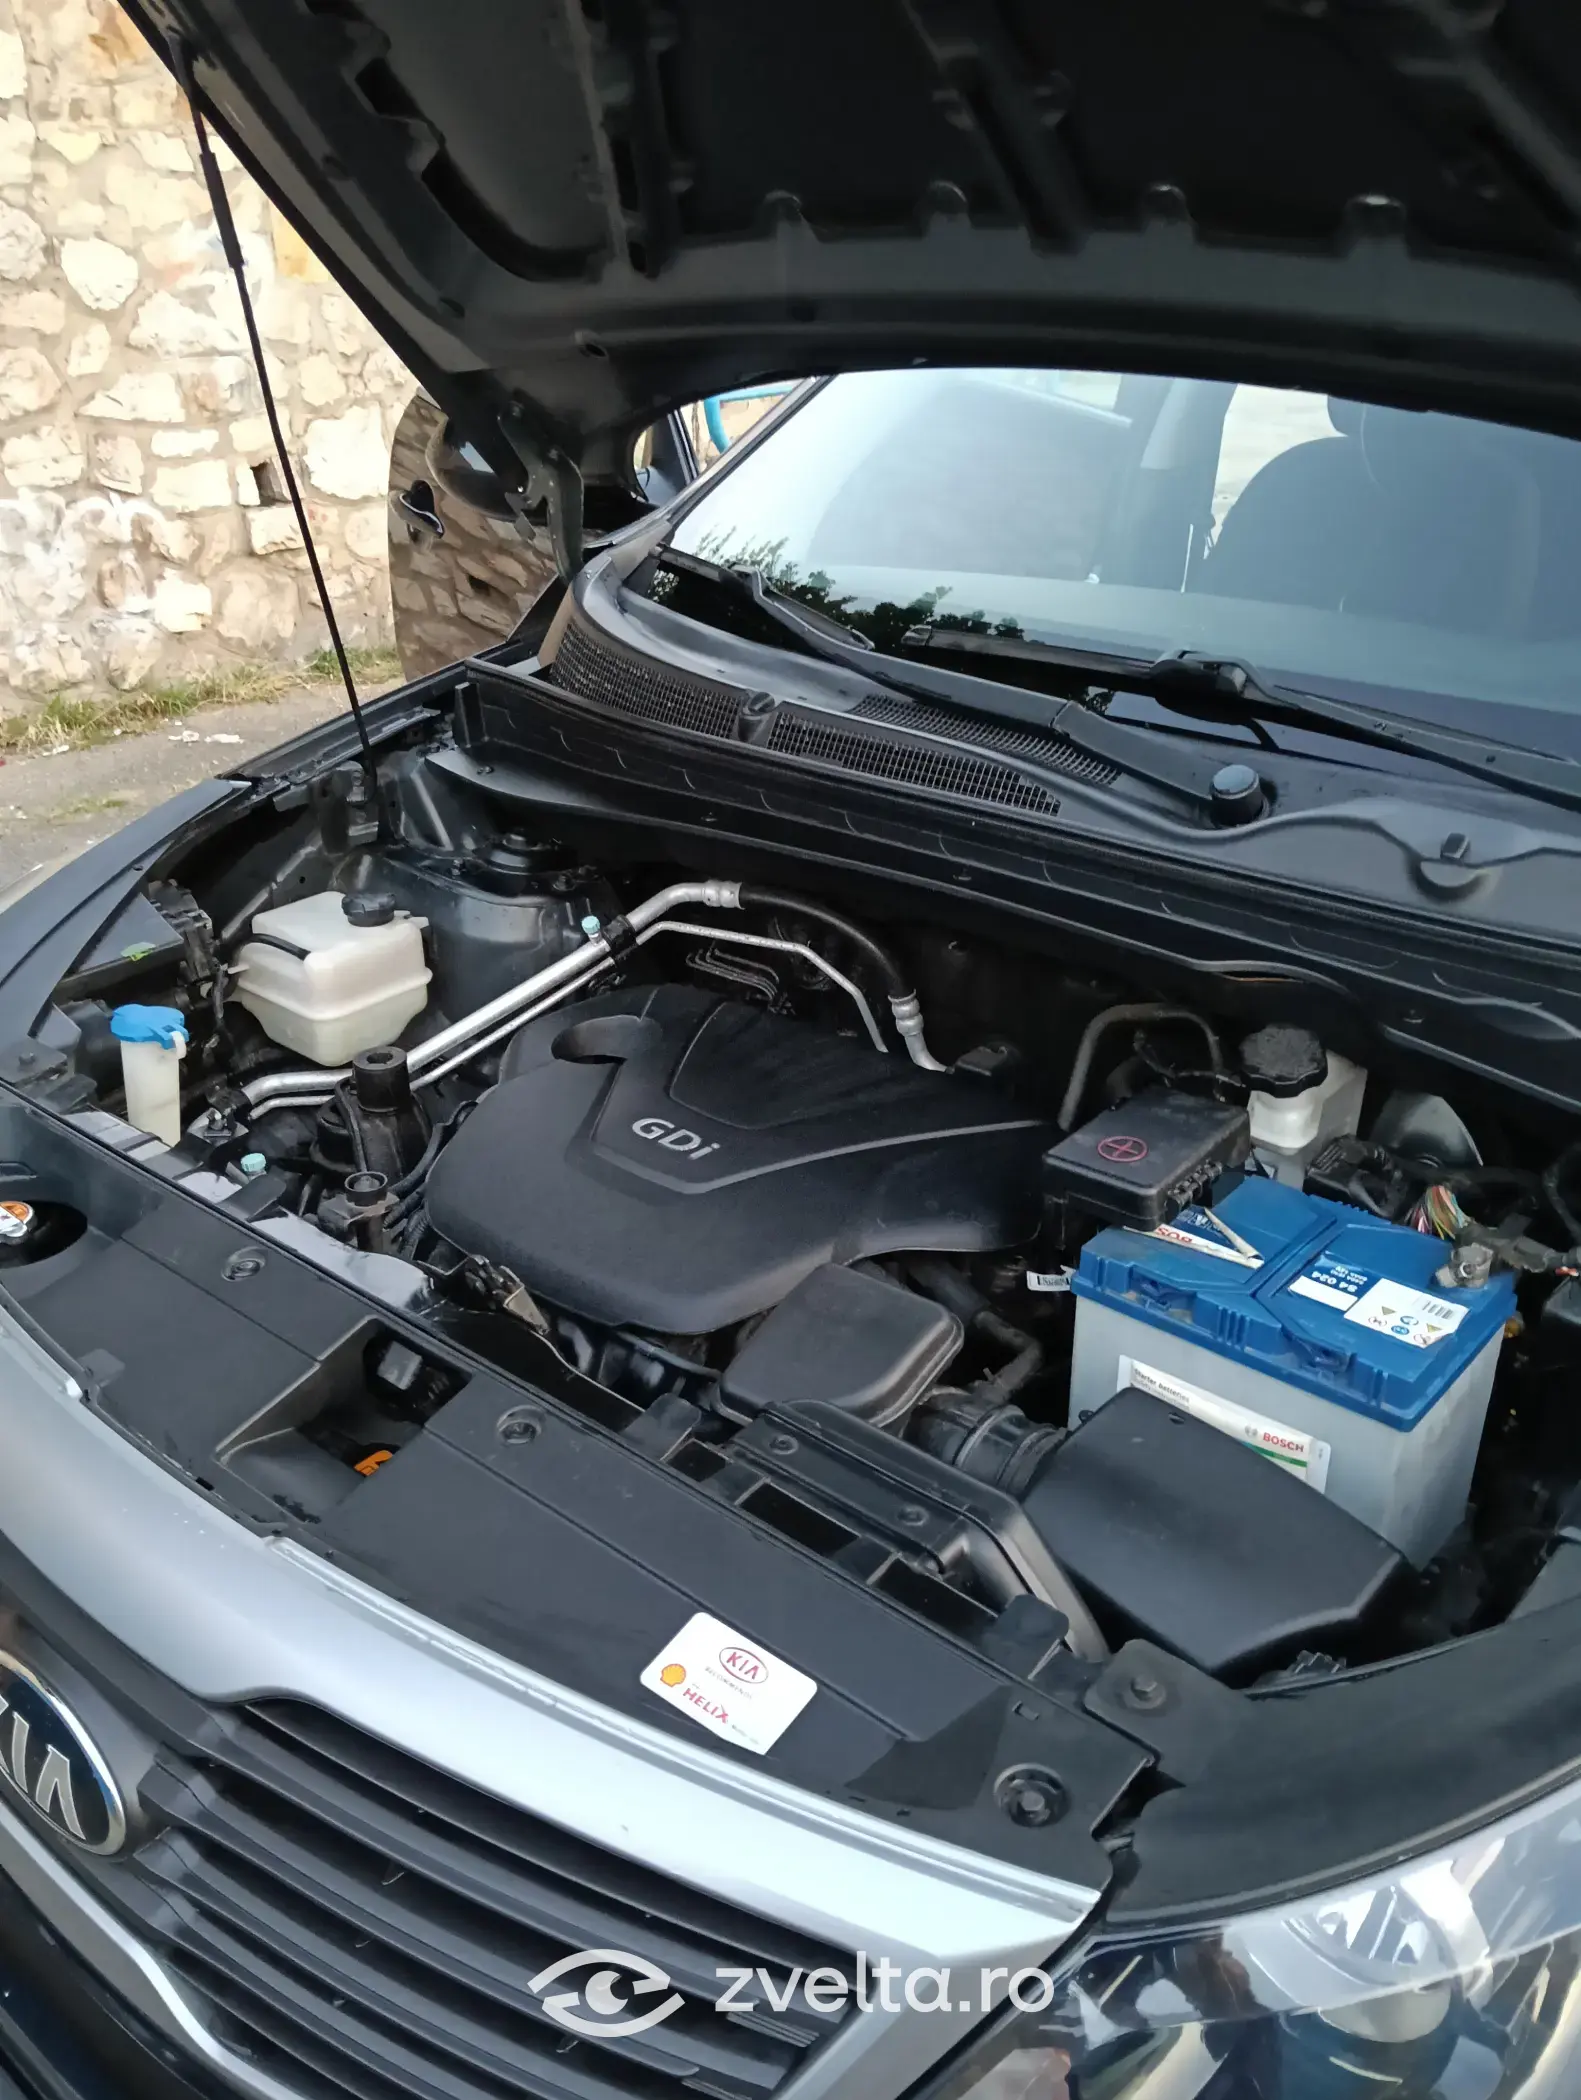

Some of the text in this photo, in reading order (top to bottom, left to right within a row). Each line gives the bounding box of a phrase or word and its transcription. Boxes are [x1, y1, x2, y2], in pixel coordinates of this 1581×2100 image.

[632, 1118, 720, 1160] GDi
[1134, 1368, 1190, 1403] Starter batteries
[1263, 1432, 1305, 1453] BOSCH
[726, 1651, 760, 1680] KIA
[683, 1687, 729, 1724] HELIX
